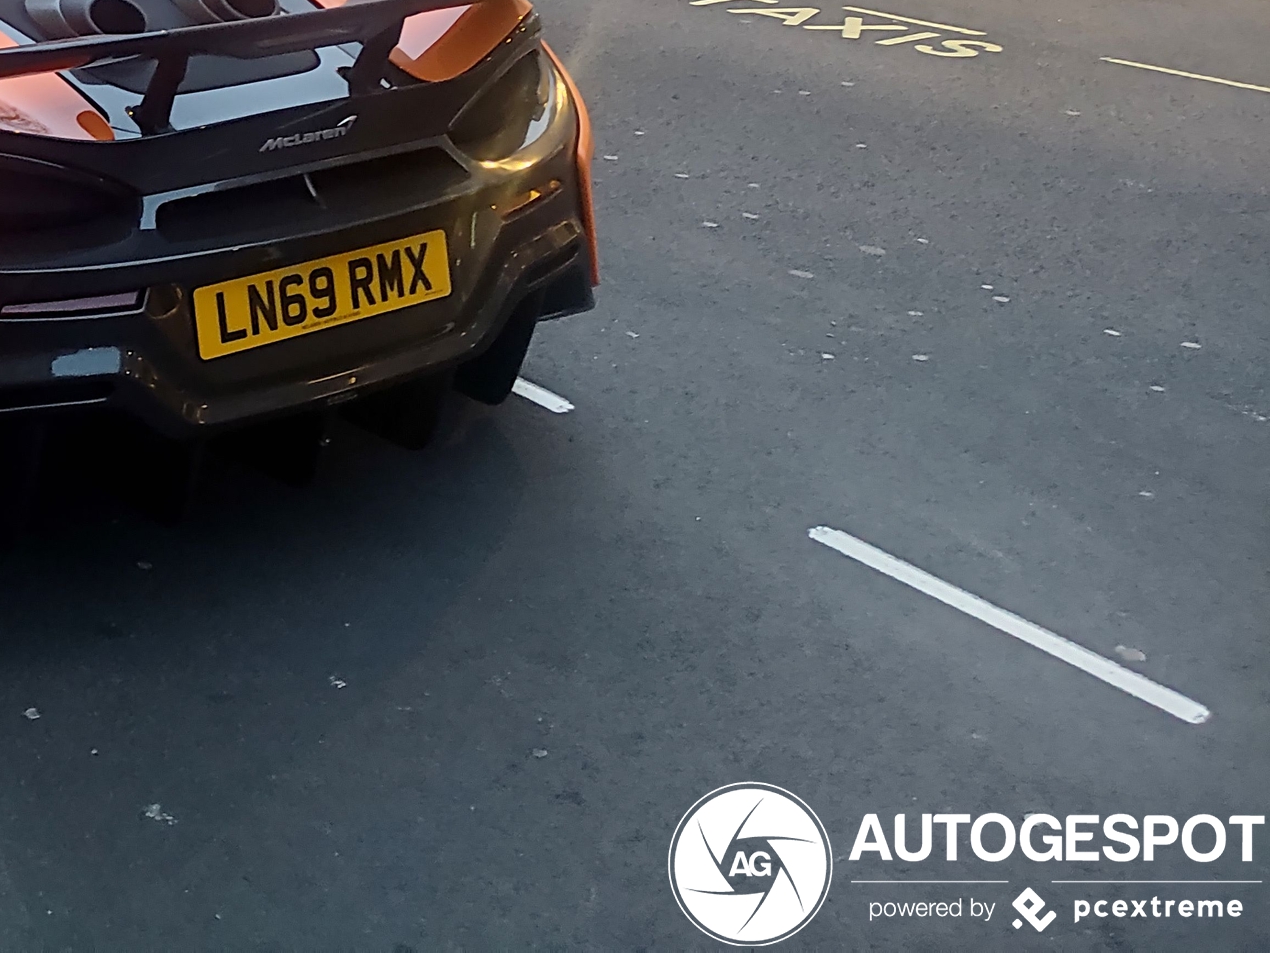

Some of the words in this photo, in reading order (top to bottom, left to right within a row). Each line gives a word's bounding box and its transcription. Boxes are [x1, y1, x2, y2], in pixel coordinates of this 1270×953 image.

[259, 126, 347, 152] McLaren
[216, 267, 338, 344] LN69
[348, 243, 433, 310] RMX
